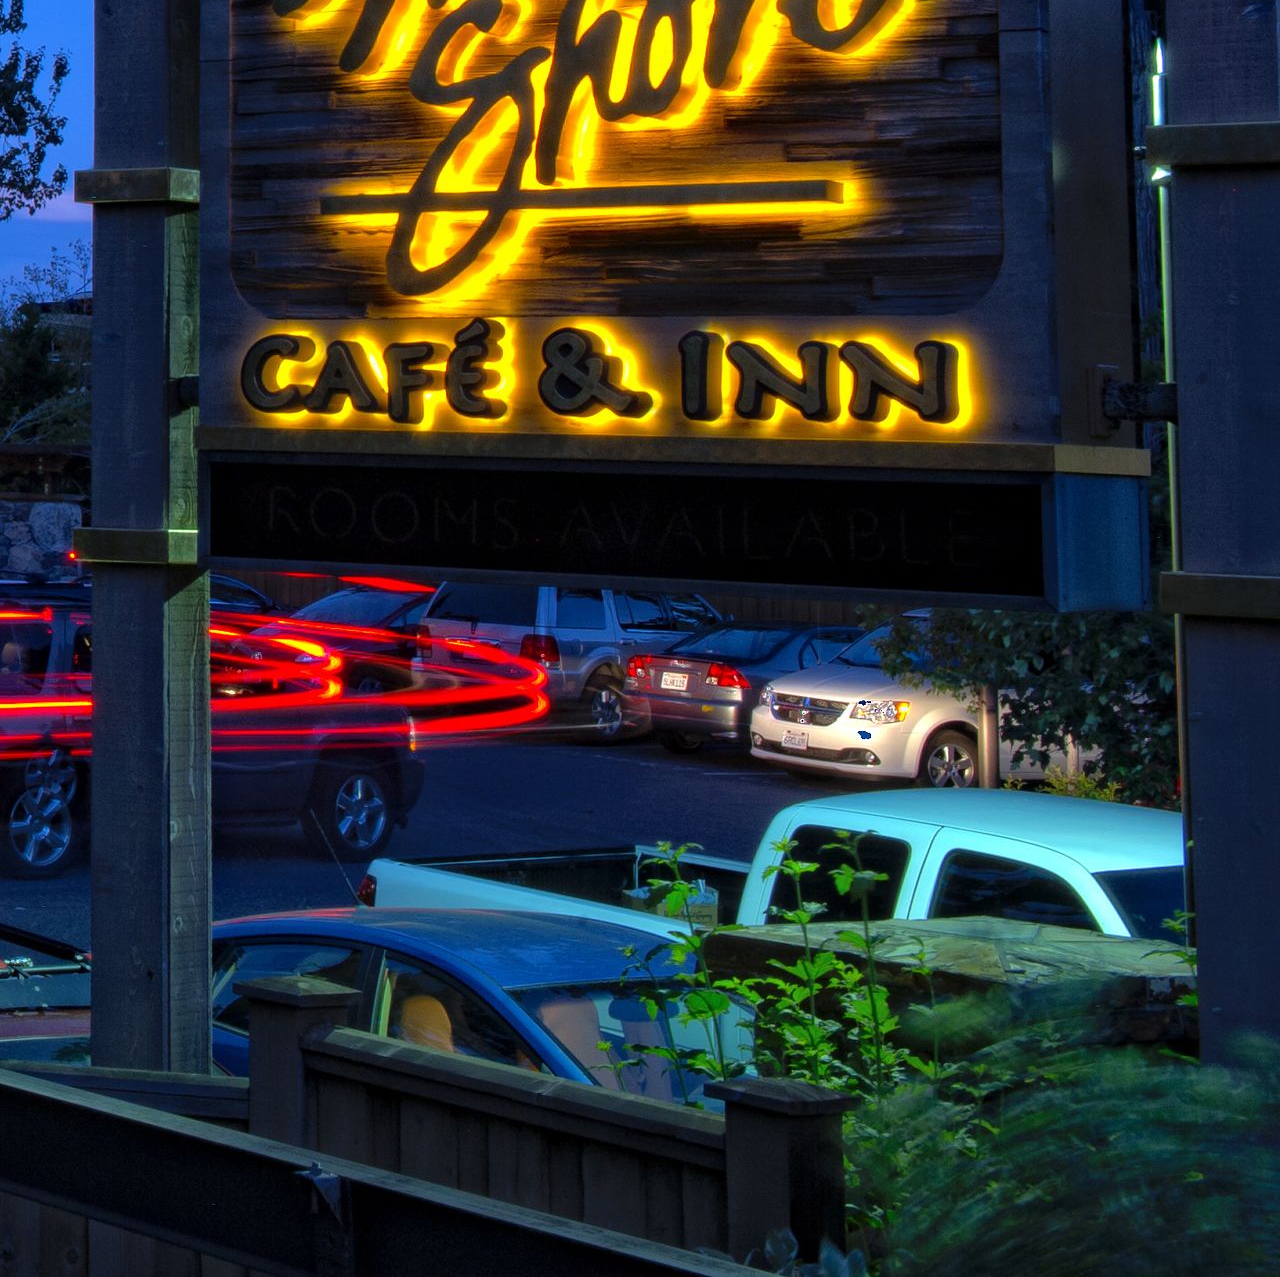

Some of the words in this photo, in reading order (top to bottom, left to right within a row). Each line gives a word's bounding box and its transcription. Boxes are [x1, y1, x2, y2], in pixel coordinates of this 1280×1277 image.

[240, 318, 508, 424] CAFÉ
[539, 325, 654, 420] &
[679, 328, 963, 424] INN
[262, 485, 523, 551] ROOMS
[555, 499, 986, 568] AVAILABLE
